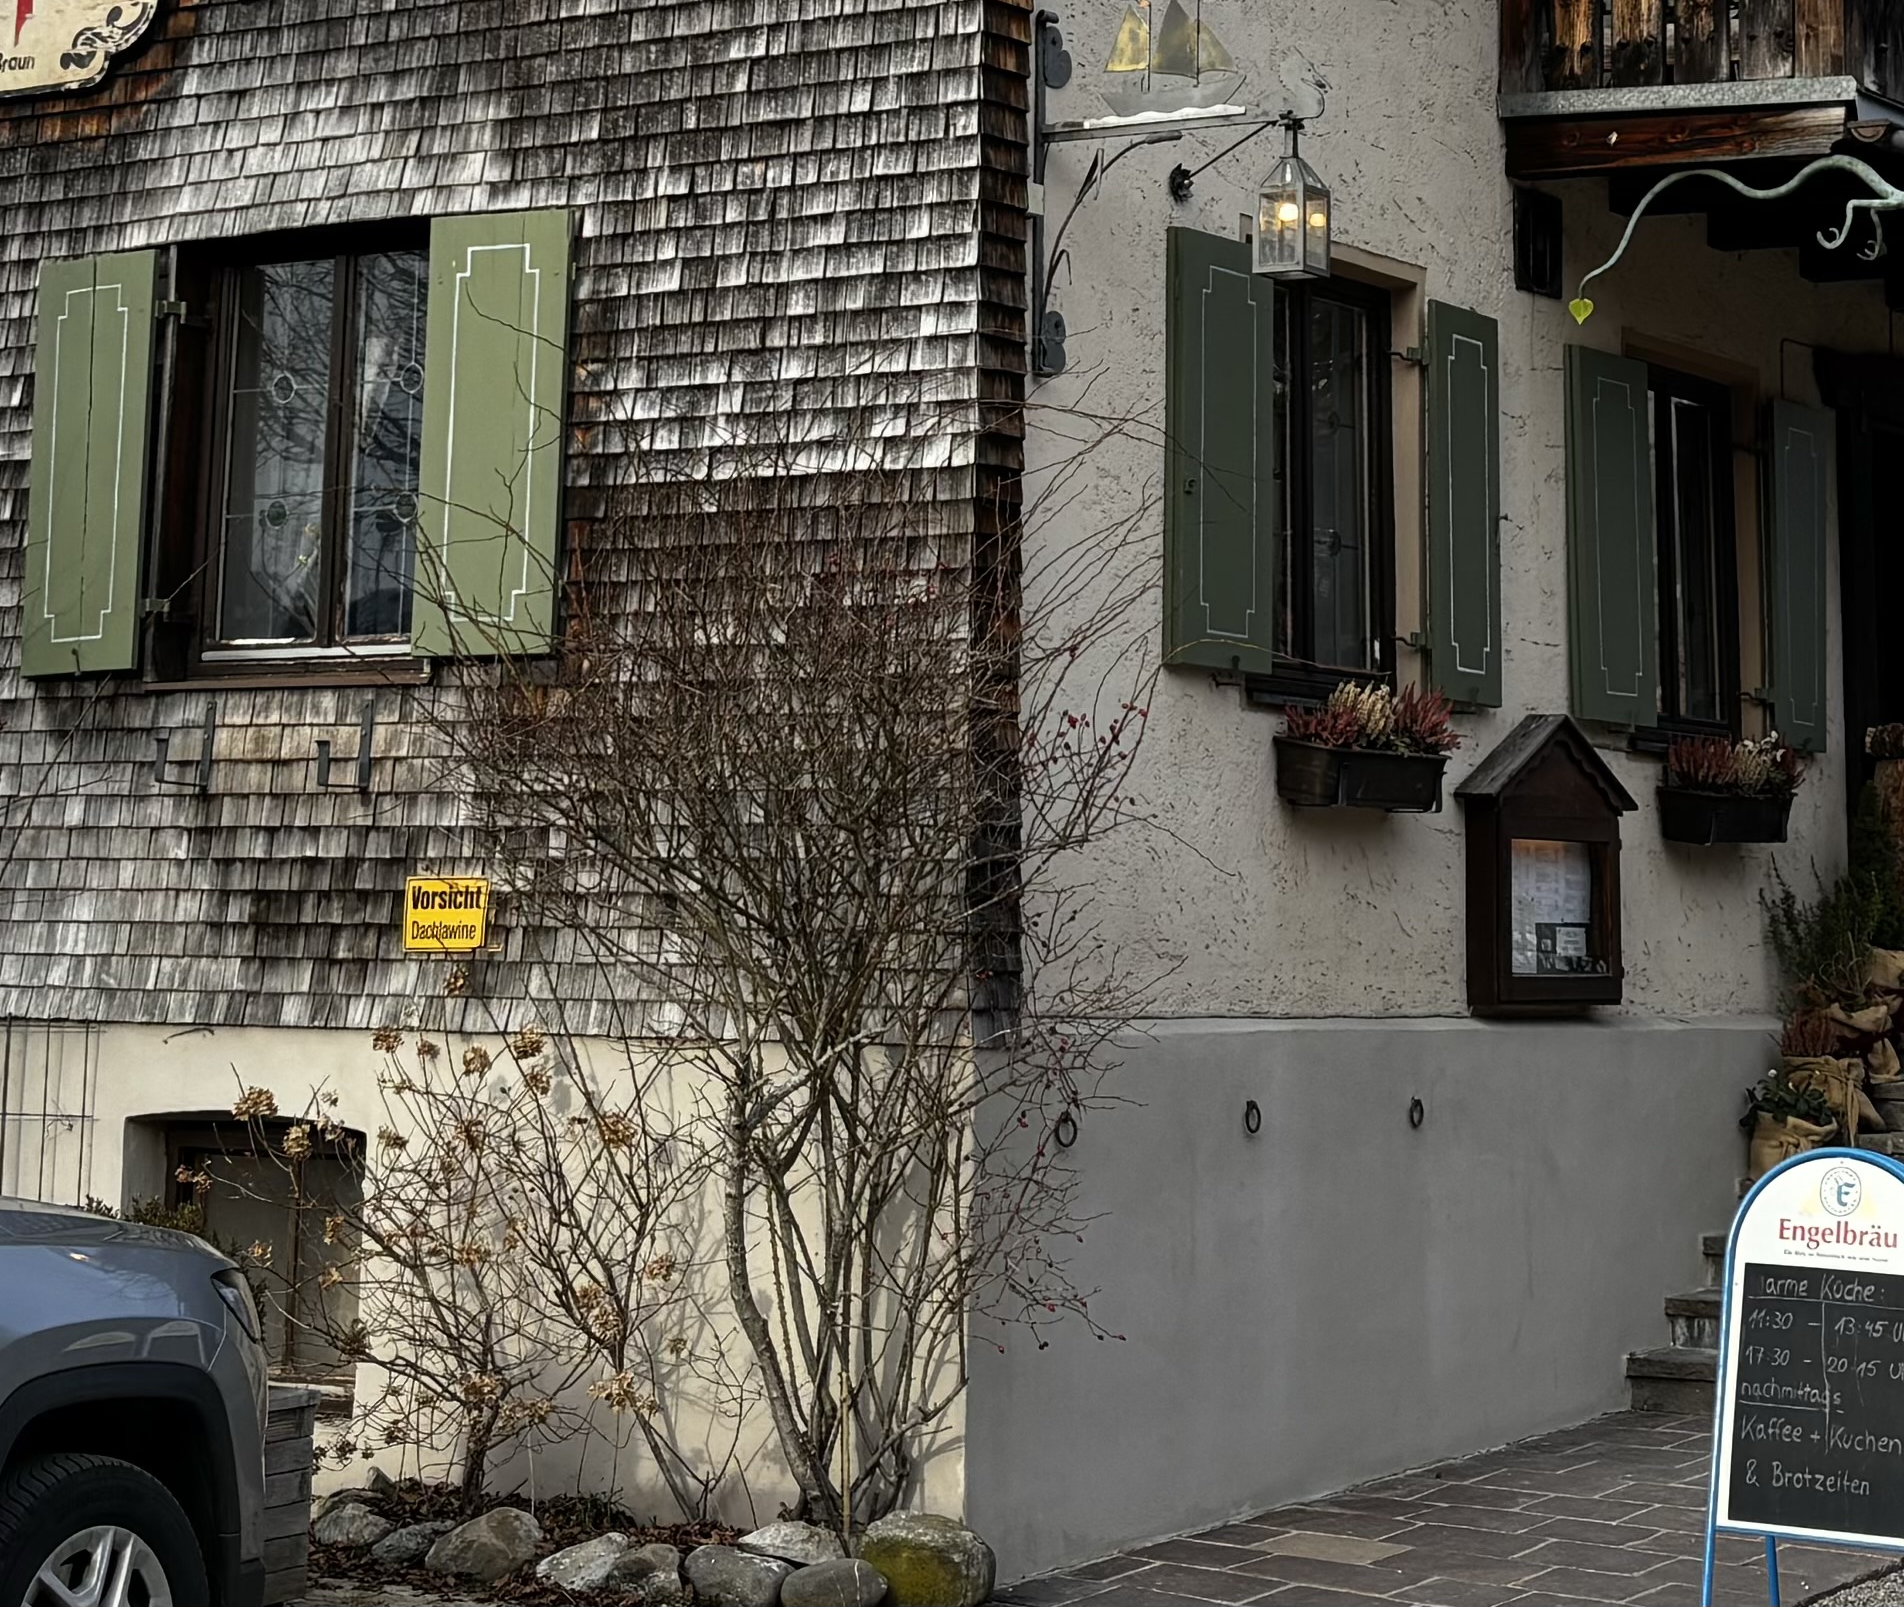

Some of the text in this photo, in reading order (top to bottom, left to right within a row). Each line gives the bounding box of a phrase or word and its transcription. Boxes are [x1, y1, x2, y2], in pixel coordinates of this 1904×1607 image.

[412, 885, 482, 910] Vorsicht
[412, 920, 476, 940] Dachlawine
[1778, 1218, 1898, 1249] Engelbräu
[1760, 1276, 1808, 1296] arme
[1749, 1308, 1793, 1330] 11:30
[1741, 1414, 1802, 1442] Kaffee
[1829, 1424, 1902, 1455] Kuchen
[1745, 1458, 1870, 1495] & Brotzeiten
